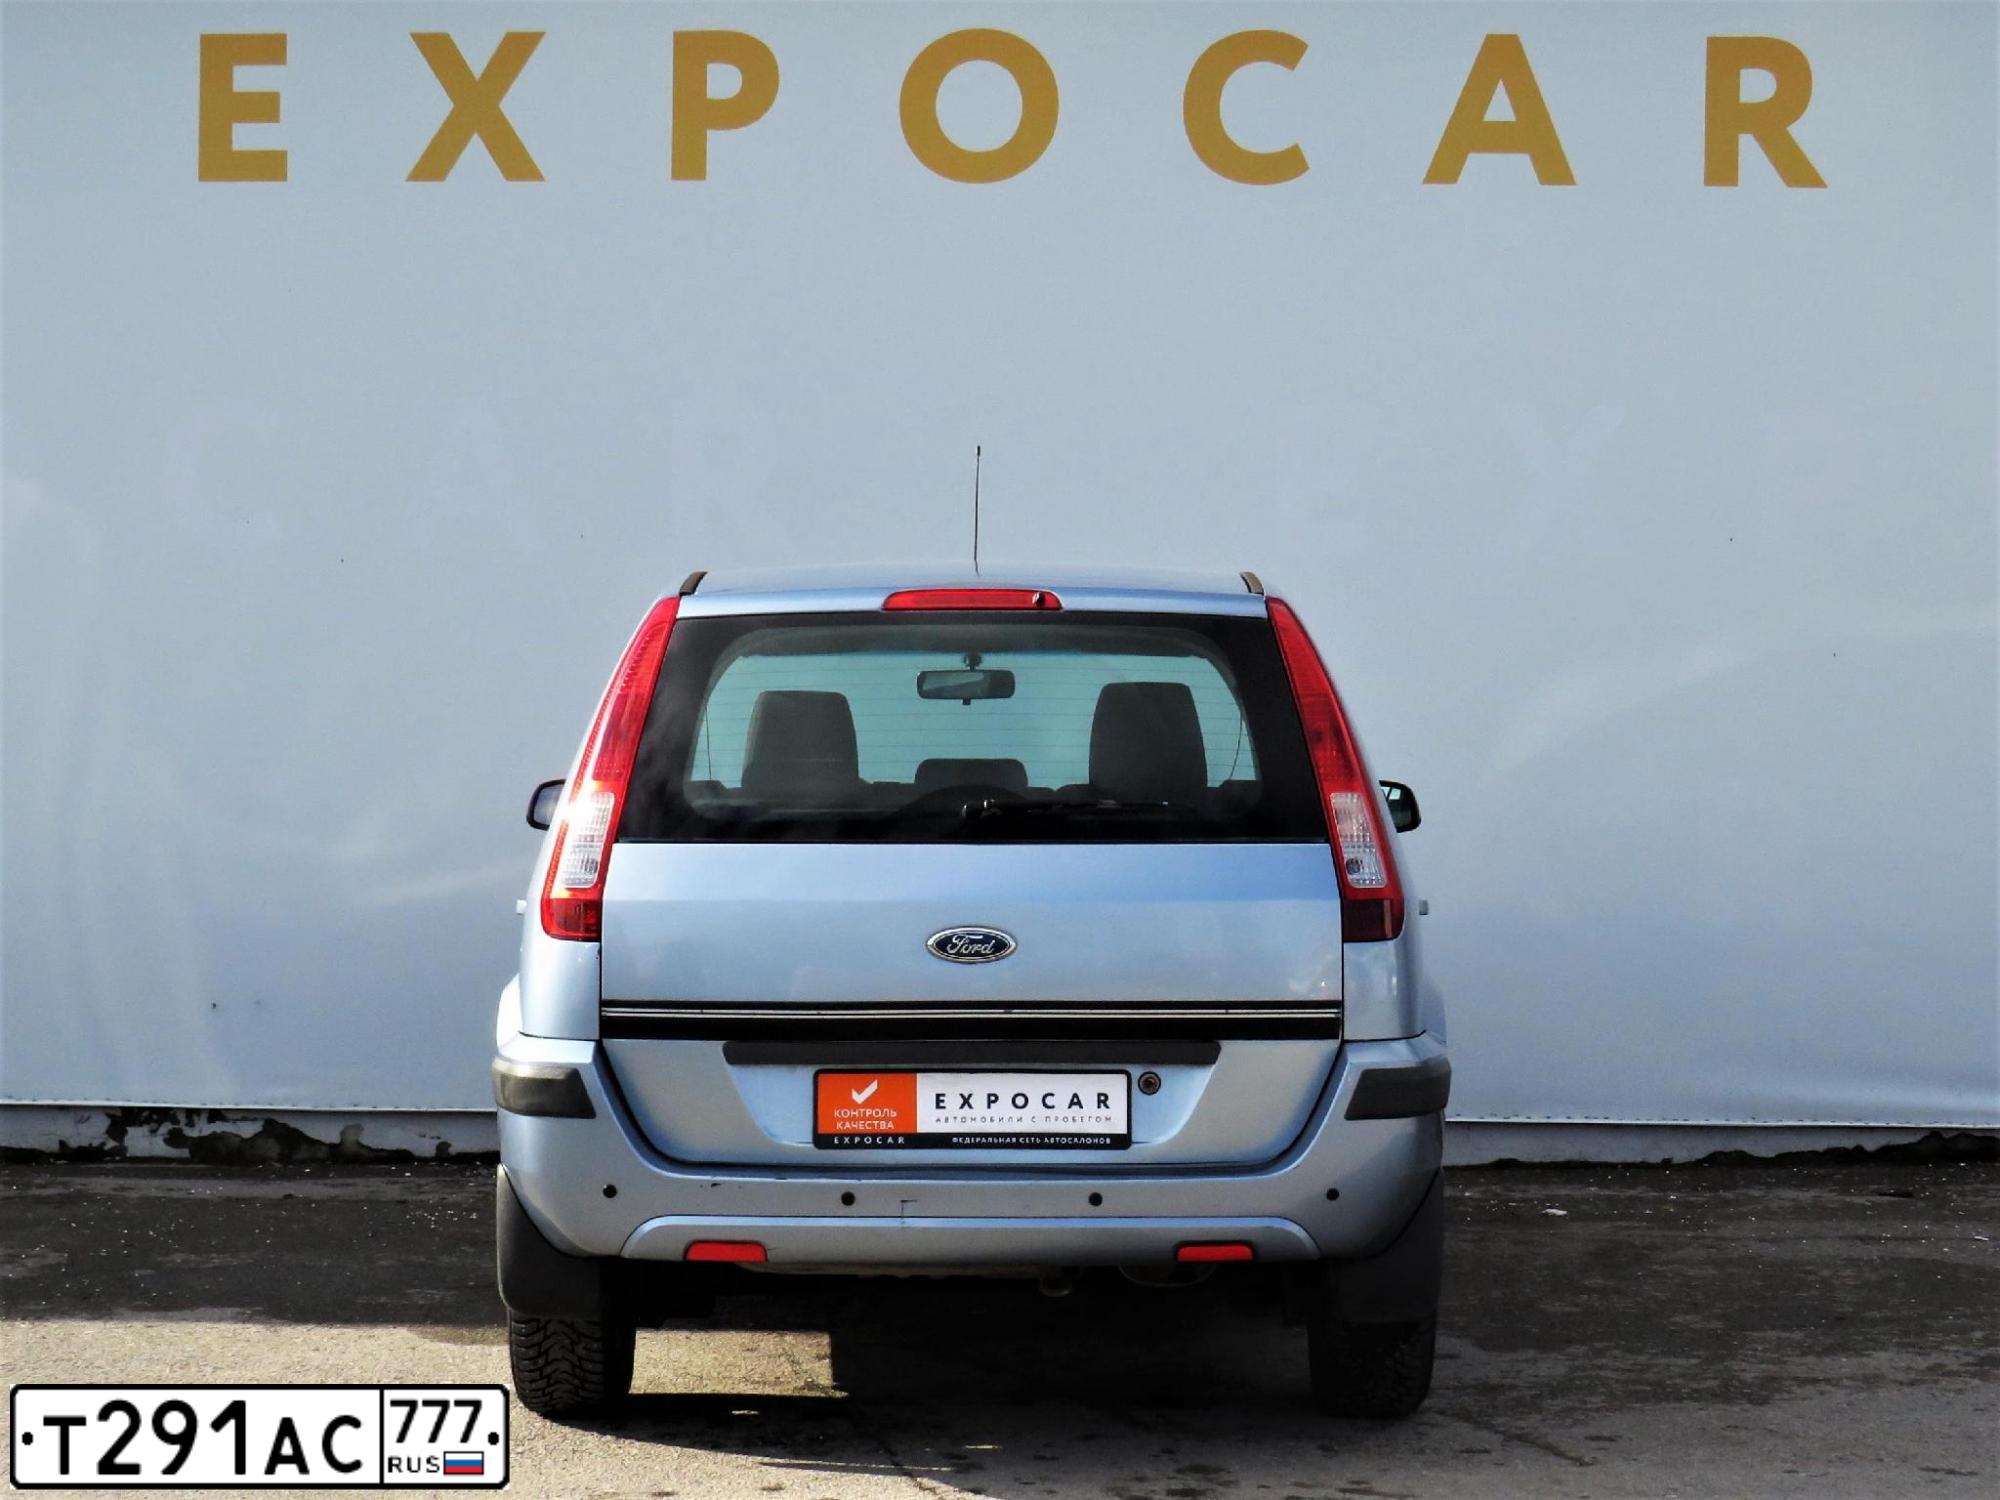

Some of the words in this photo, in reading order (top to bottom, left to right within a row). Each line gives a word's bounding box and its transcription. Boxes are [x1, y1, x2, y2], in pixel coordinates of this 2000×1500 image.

[200, 29, 1825, 187] EXPOCAR
[946, 933, 996, 954] Ford
[935, 1092, 1111, 1110] EXPOCAR
[833, 1108, 897, 1118] КОНТРОЛЬ
[835, 1120, 895, 1130] КАЧЕСТВА
[833, 1136, 905, 1144] EXPOCAR
